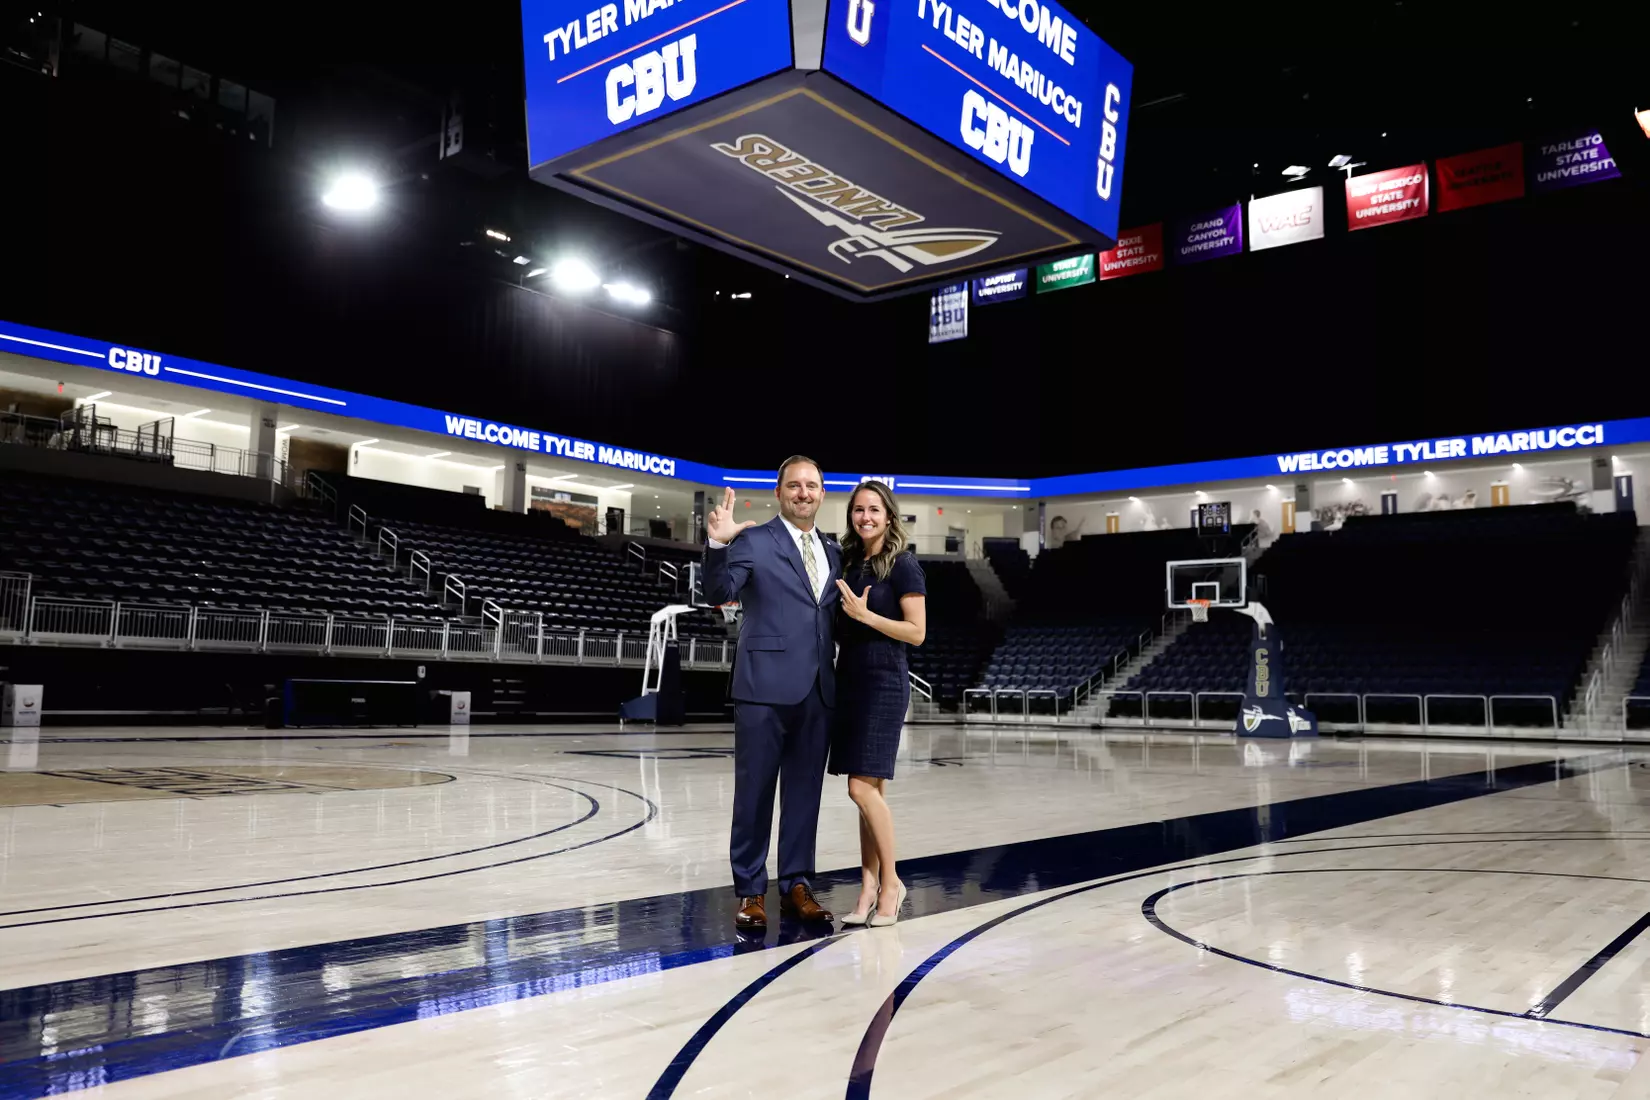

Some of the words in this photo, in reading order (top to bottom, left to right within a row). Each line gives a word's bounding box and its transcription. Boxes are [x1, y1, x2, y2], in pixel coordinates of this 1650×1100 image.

[543, 3, 619, 61] TYLER
[917, 0, 984, 60] TYLER
[987, 37, 1082, 128] MARIUCCI
[605, 33, 697, 125] CBU
[960, 89, 1034, 178] CBU
[1097, 82, 1120, 201] CBU
[1556, 147, 1598, 166] STATE
[710, 134, 926, 231] LANCERS
[1356, 197, 1420, 218] UNIVERSITY
[1371, 190, 1404, 205] STATE
[1191, 217, 1224, 232] GRAND
[1118, 236, 1142, 247] DIXIE
[1181, 236, 1234, 255] UNIVERSITY
[1187, 228, 1226, 243] CANYON
[1104, 254, 1158, 272] UNIVERSITY
[1116, 246, 1144, 259] STATE
[1042, 267, 1089, 283] UNIVERSITY
[978, 282, 1023, 297] UNIVERSITY
[108, 347, 161, 375] CBU
[445, 415, 540, 450] WELCOME
[543, 435, 595, 462] TYLER
[598, 446, 675, 476] MARIUCCI
[1277, 446, 1388, 473] WELCOME
[1392, 438, 1467, 463] TYLER
[1472, 424, 1604, 455] MARIUCCI
[1255, 648, 1269, 697] CBU
